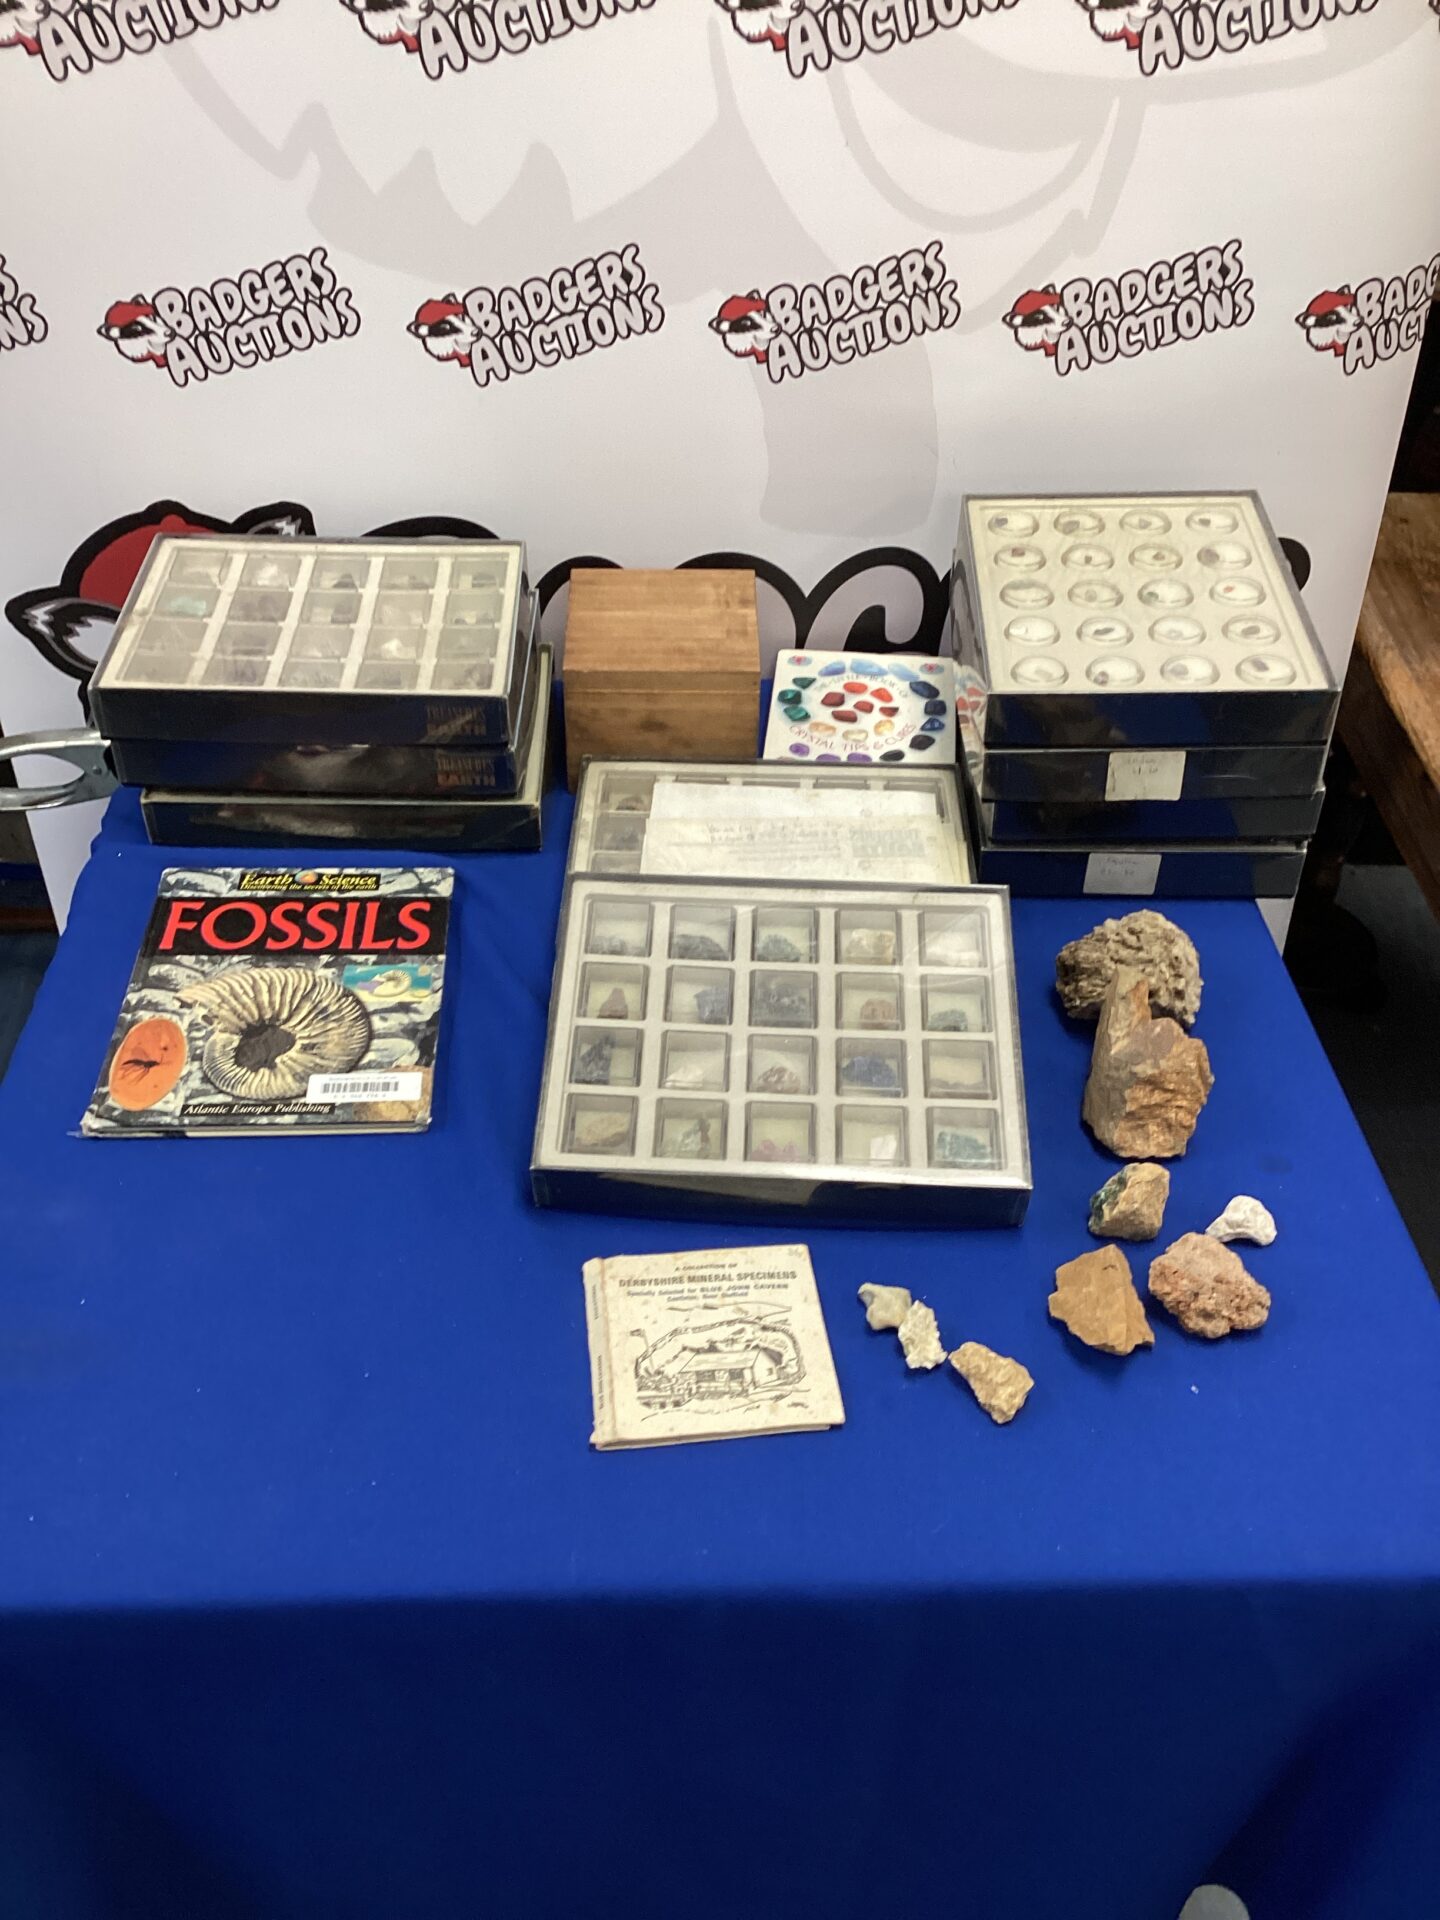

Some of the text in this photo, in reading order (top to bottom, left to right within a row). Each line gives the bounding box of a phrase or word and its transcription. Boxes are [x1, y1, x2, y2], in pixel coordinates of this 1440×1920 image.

[152, 246, 337, 340] BADGERS
[463, 243, 646, 338] BADGERS
[766, 240, 946, 336] BADGERS
[1055, 278, 1254, 377] AUCTIONS
[1061, 238, 1244, 330] BADGERS
[166, 287, 361, 387] AUCTIONS
[470, 283, 665, 387] AUCTIONS
[767, 279, 961, 384] AUCTIONS
[158, 901, 431, 950] FOSSILS
[242, 872, 377, 885] Earth Science
[184, 1103, 331, 1115] Atlantic Europe Publishing
[618, 1270, 798, 1288] DERBYSHIRE MINERAL SPECIMENS
[699, 1285, 723, 1293] BLUE
